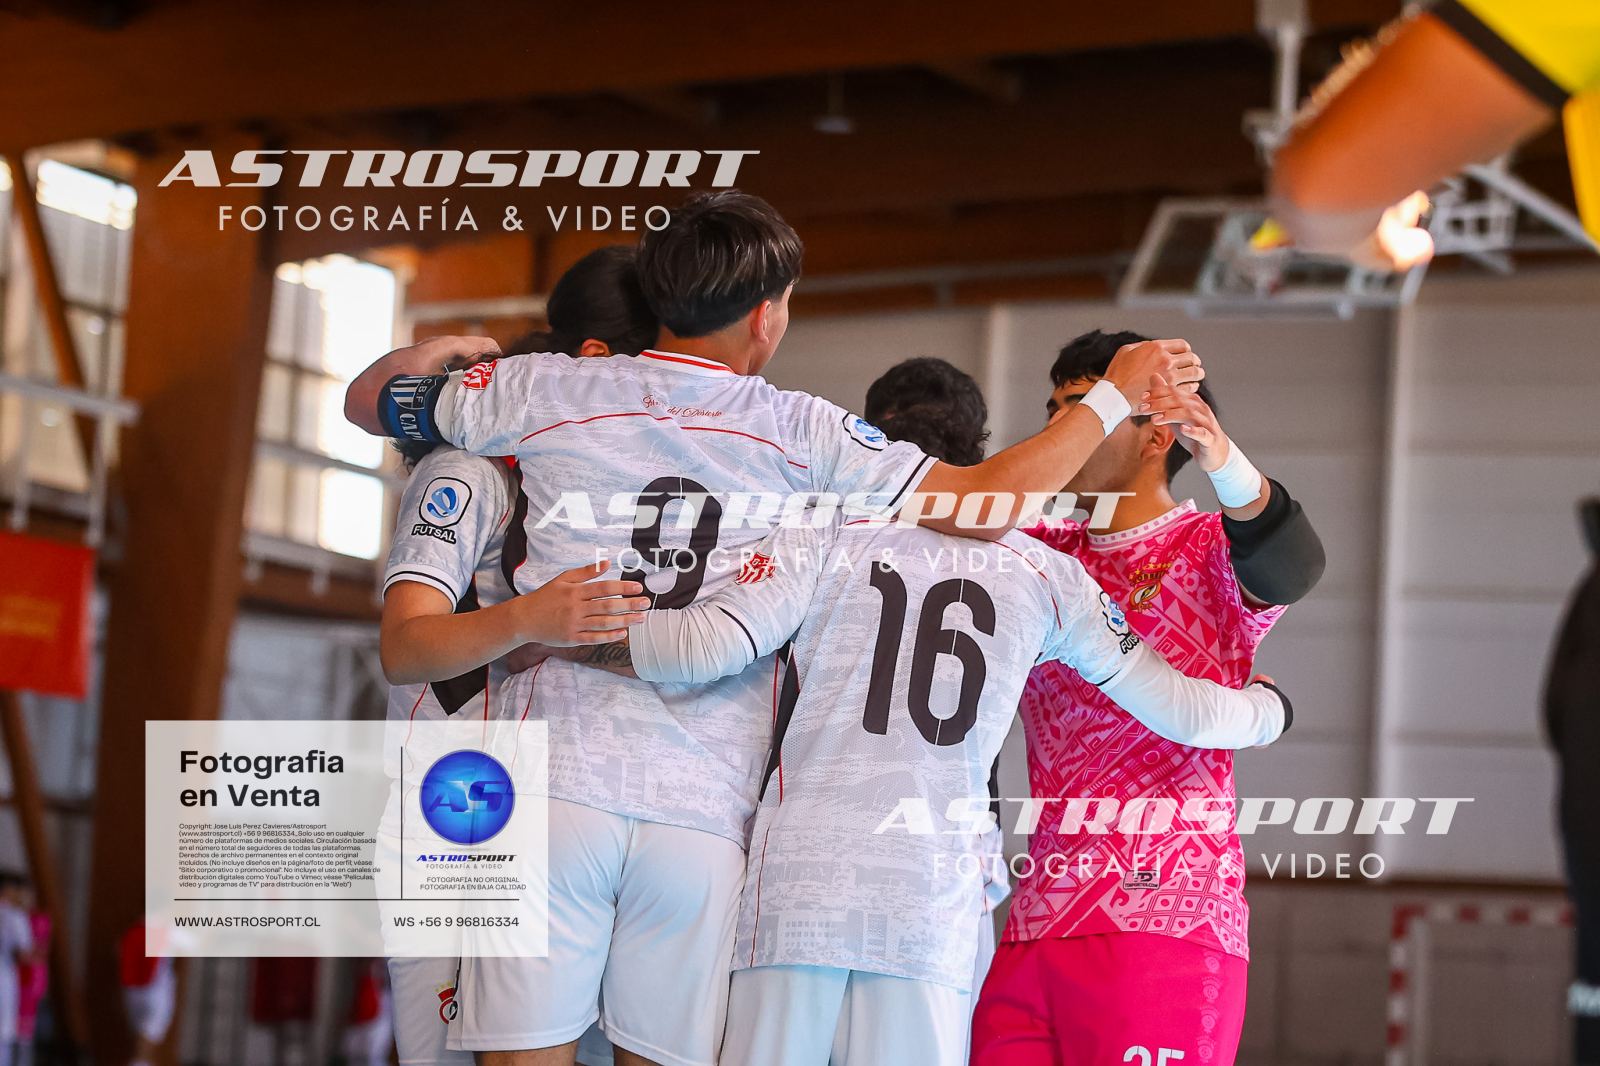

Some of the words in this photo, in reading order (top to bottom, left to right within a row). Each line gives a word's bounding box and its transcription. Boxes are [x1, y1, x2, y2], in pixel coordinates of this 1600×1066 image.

[411, 524, 456, 544] FUTSAL
[620, 476, 722, 610] 9
[862, 561, 996, 746] 16
